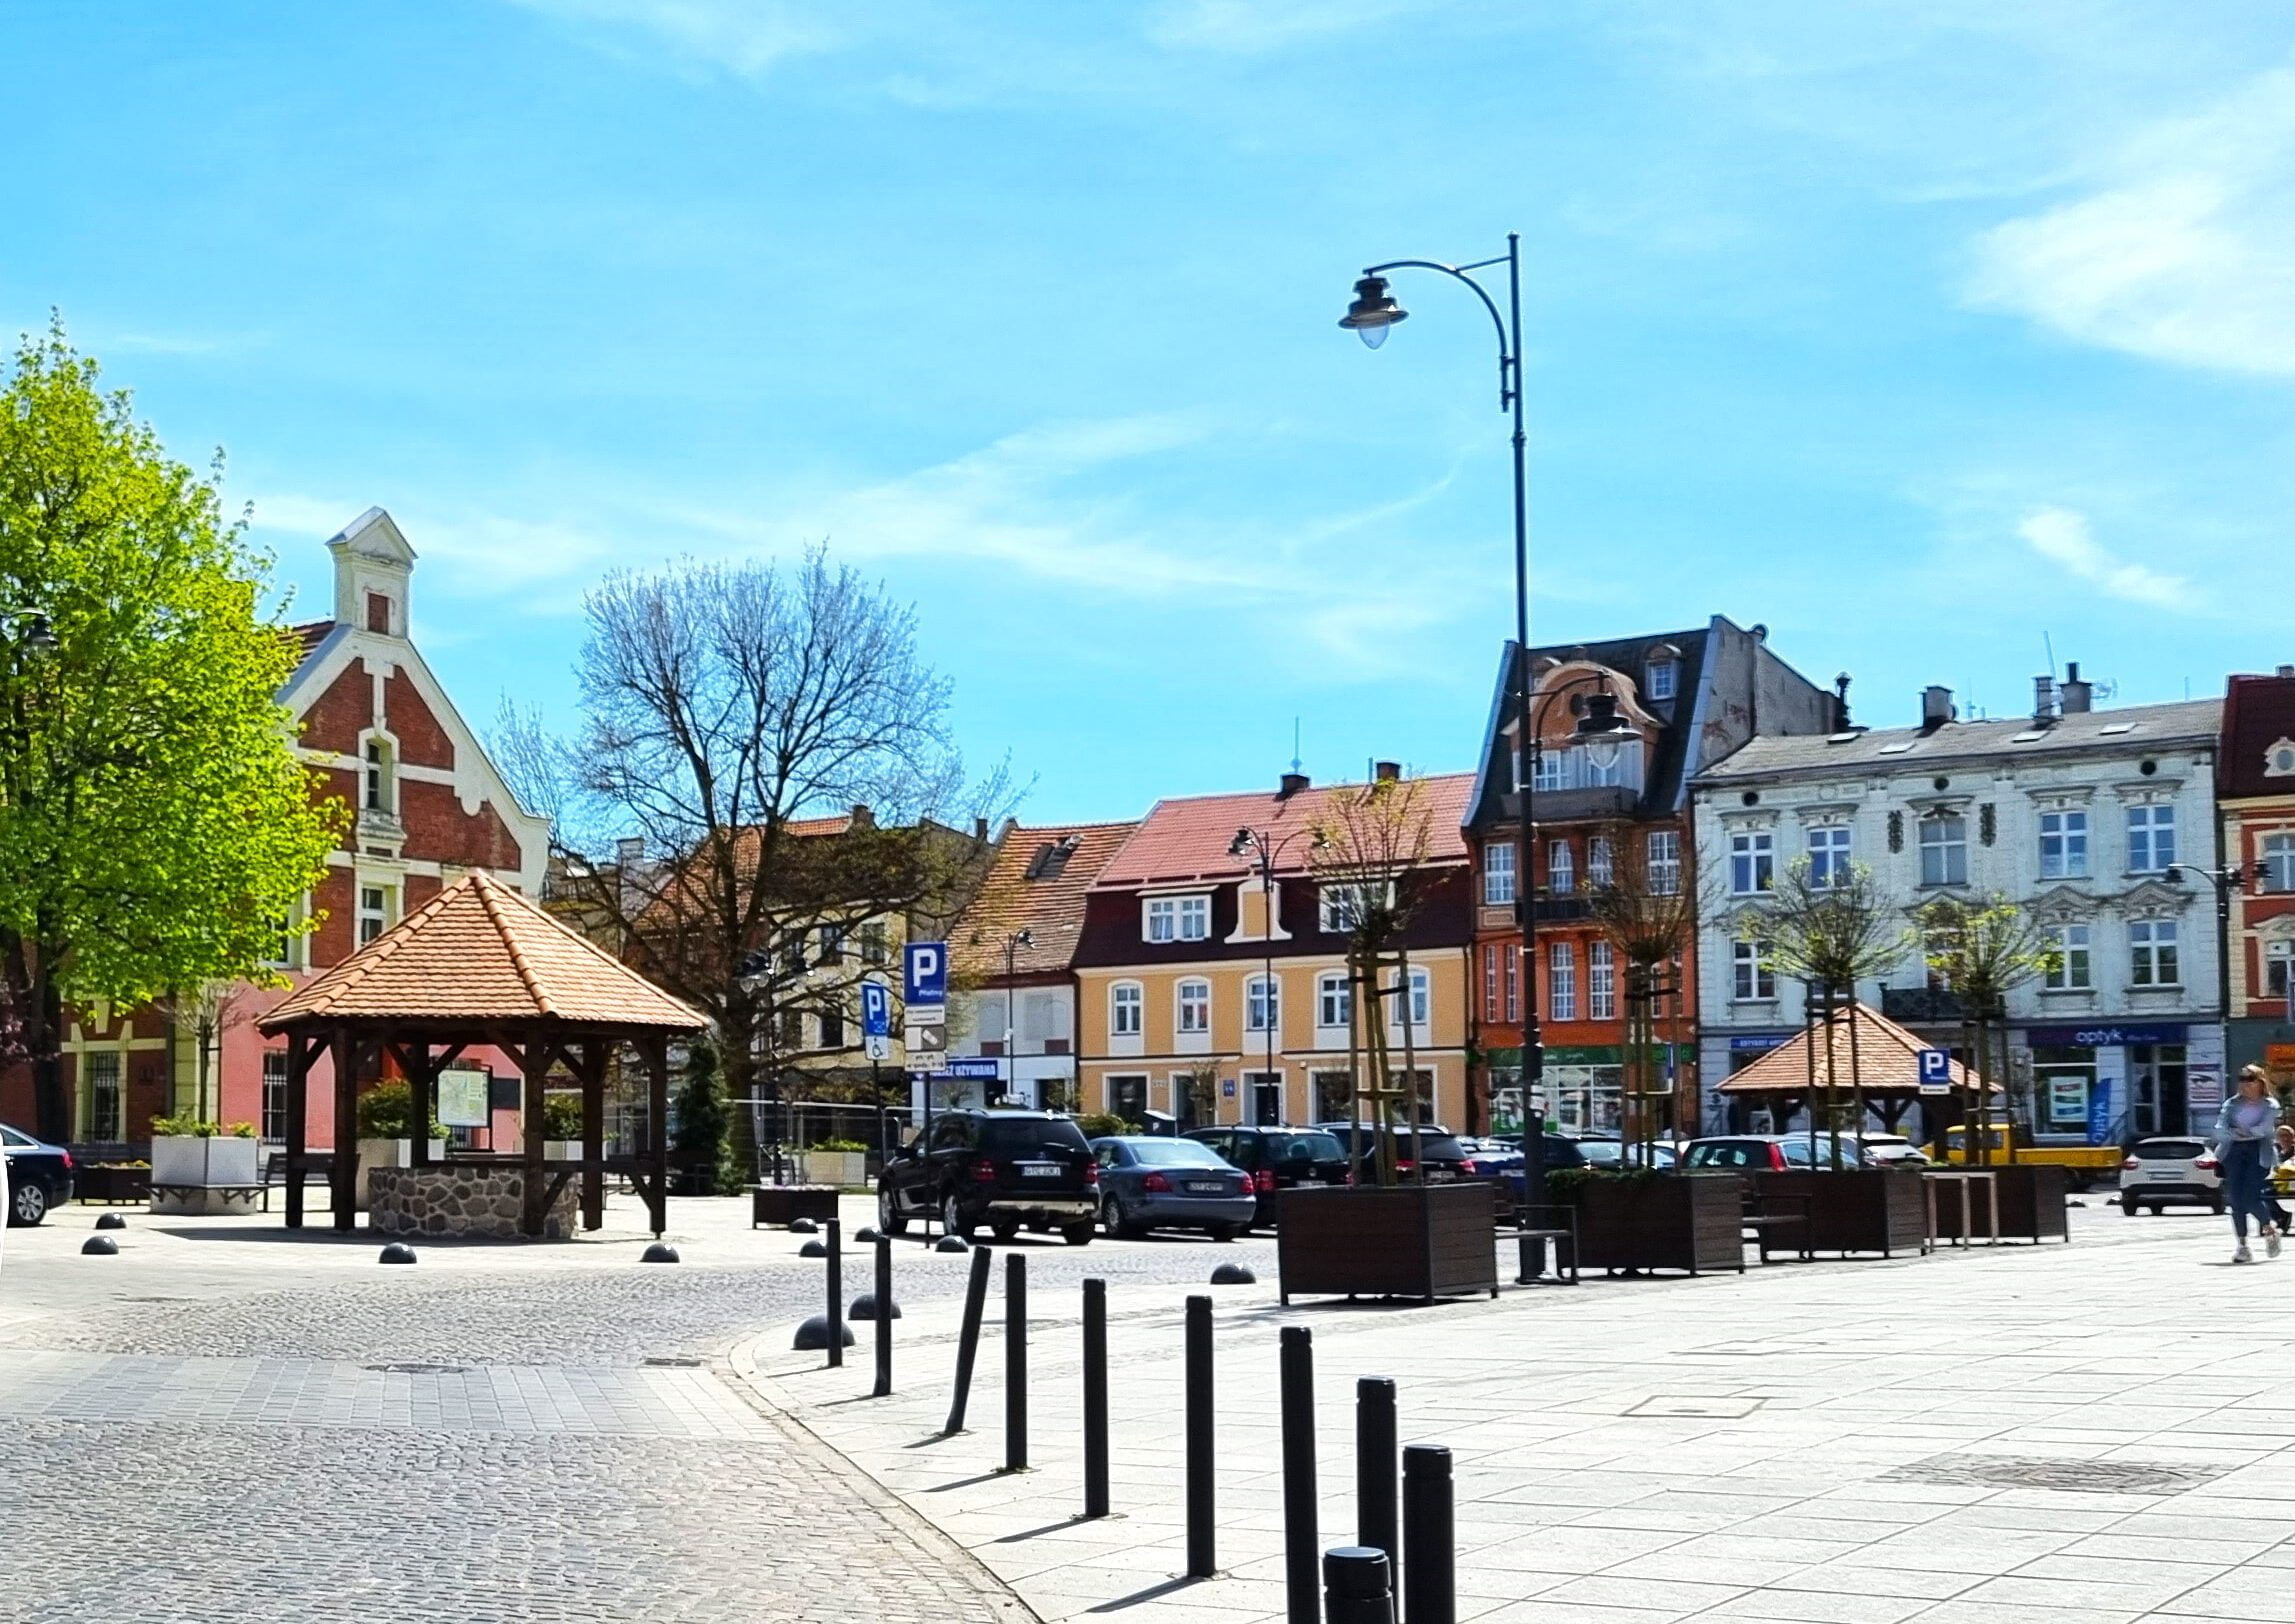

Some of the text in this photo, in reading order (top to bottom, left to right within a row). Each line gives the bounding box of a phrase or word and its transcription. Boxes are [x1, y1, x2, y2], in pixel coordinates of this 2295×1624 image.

[913, 948, 937, 987] P
[867, 988, 882, 1020] P
[2075, 1029, 2123, 1044] optyk
[1925, 1052, 1944, 1075] P
